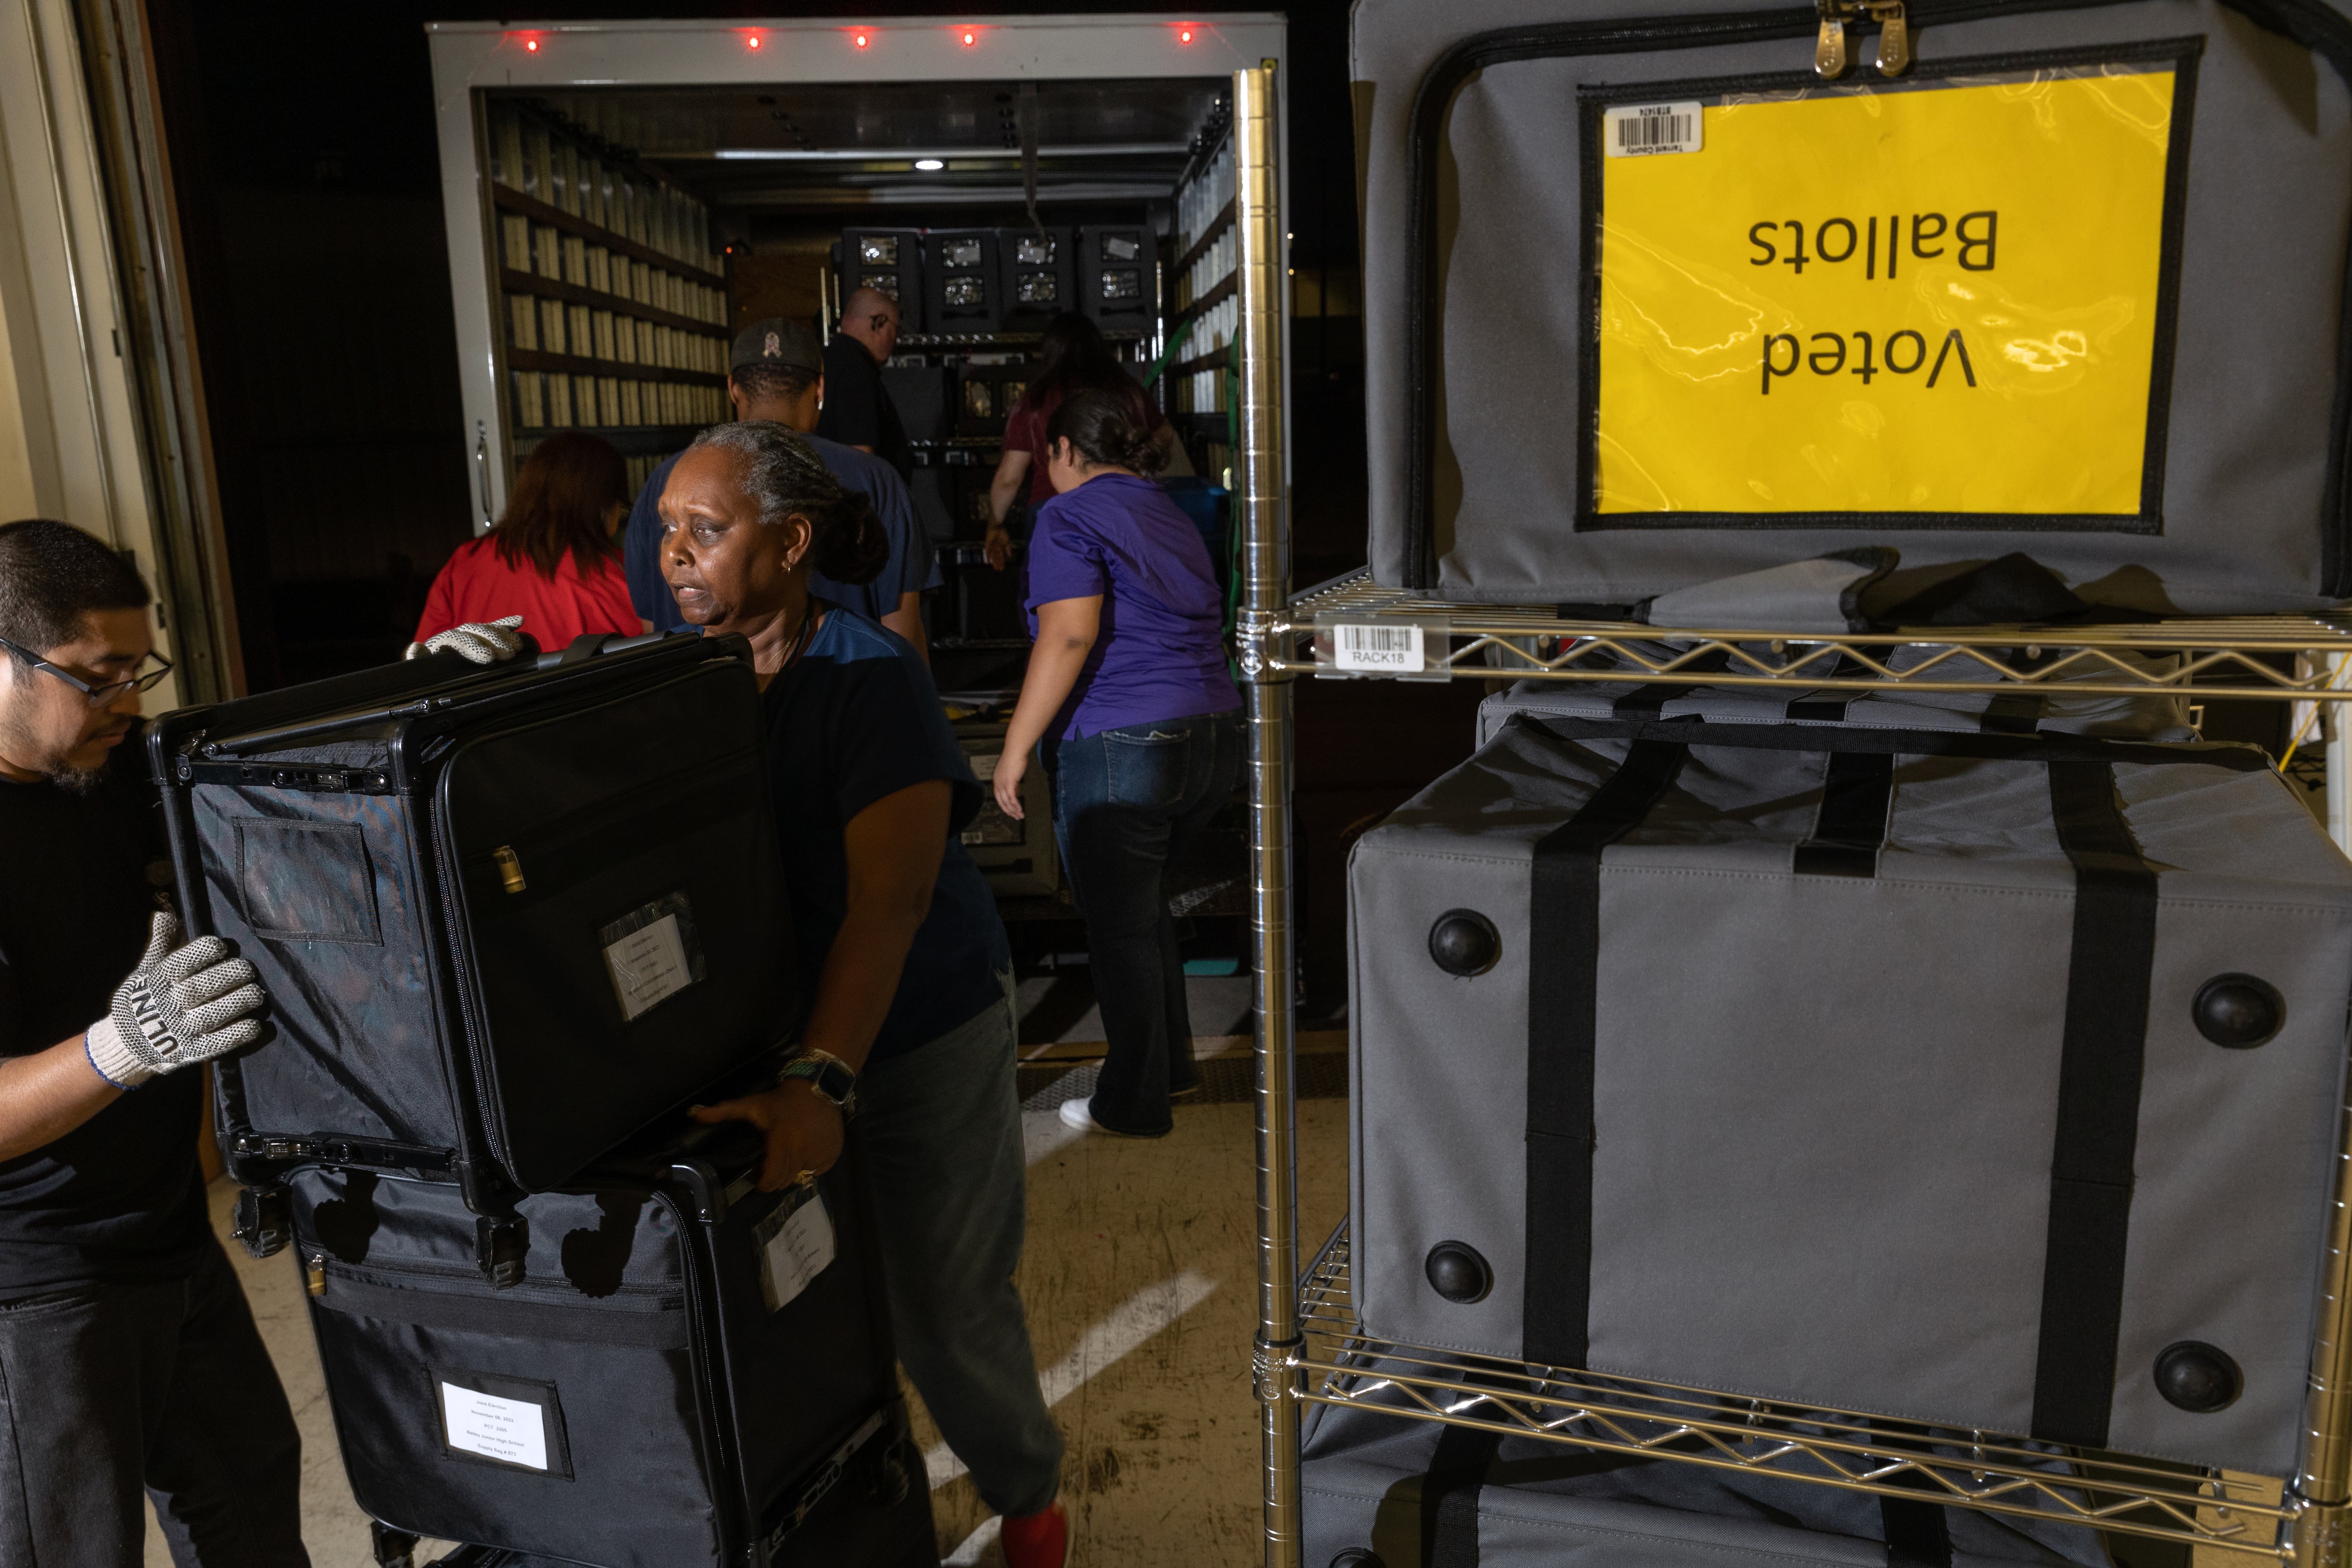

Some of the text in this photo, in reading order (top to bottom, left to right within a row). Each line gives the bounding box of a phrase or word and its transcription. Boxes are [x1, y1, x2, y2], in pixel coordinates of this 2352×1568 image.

[1626, 145, 1683, 154] Tarrant County
[1749, 210, 1997, 280] Ballots
[1761, 329, 1977, 395] Voted
[1353, 652, 1404, 663] RACK18
[132, 978, 179, 1055] ULINE
[471, 1410, 493, 1418] November
